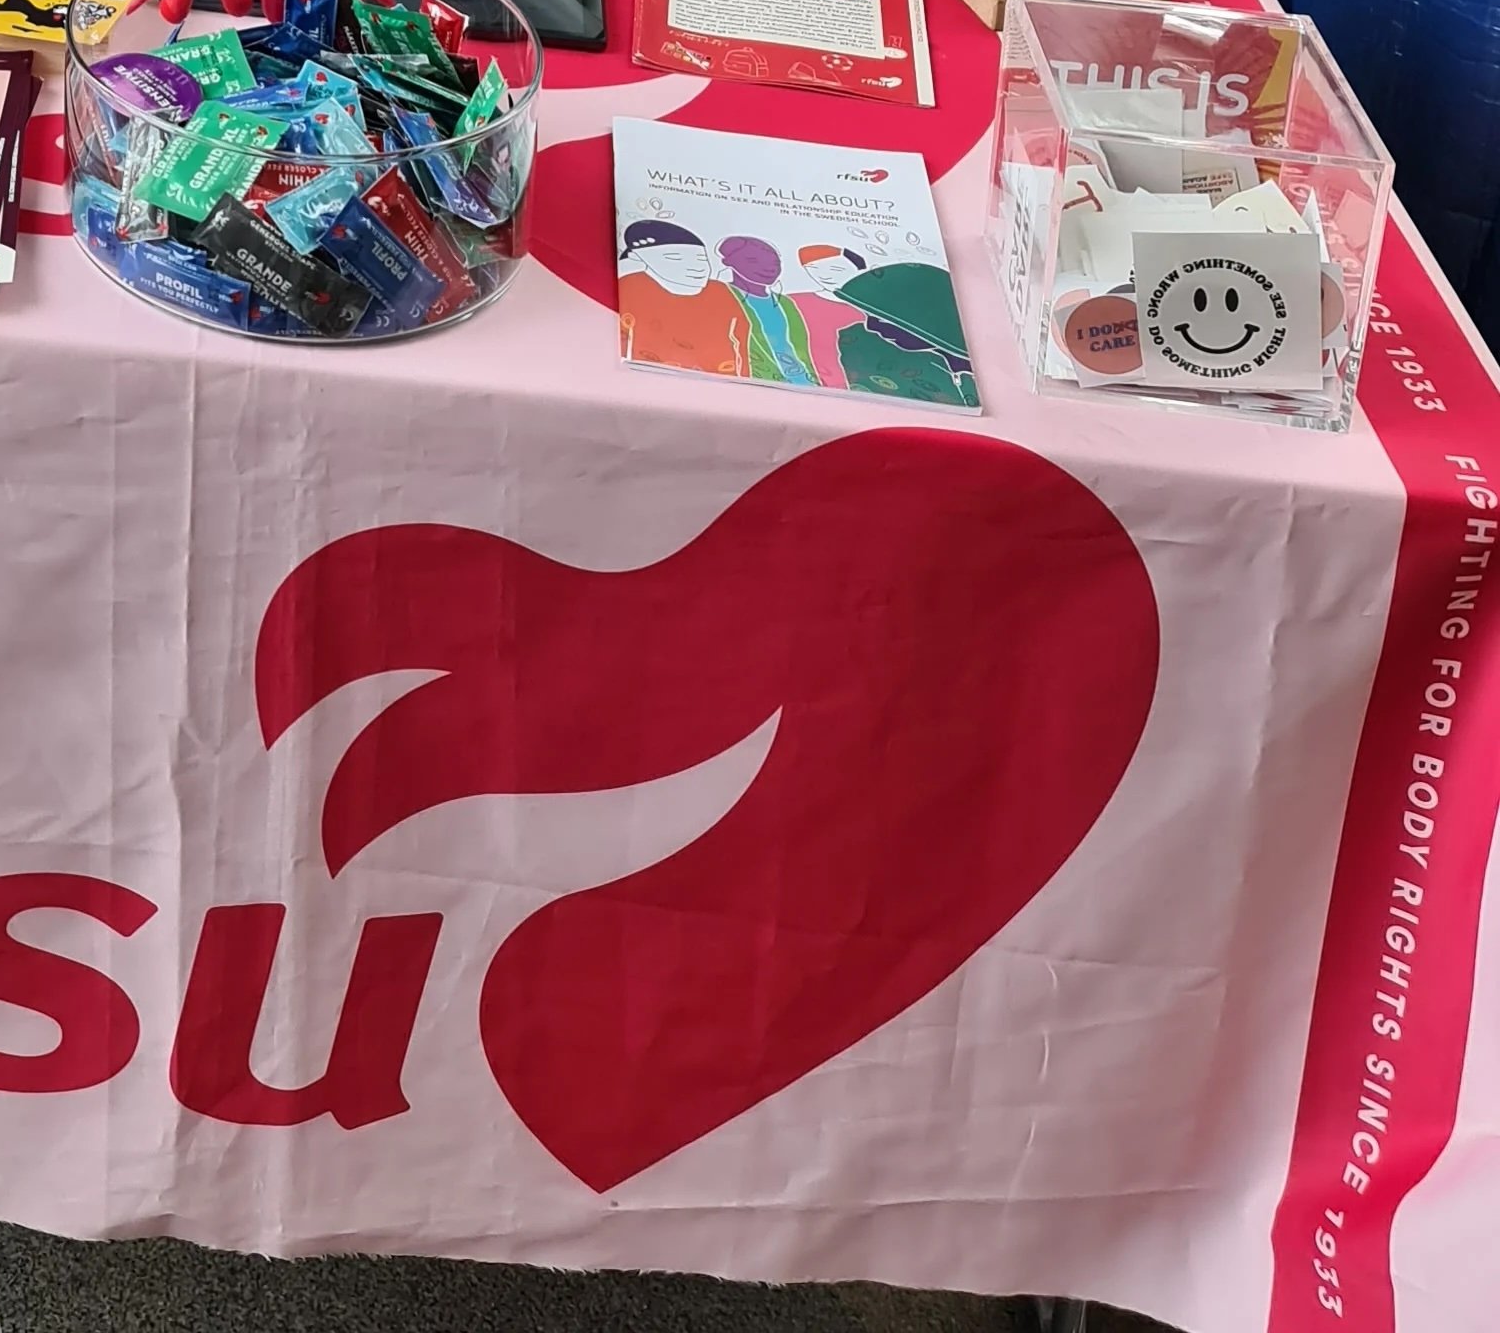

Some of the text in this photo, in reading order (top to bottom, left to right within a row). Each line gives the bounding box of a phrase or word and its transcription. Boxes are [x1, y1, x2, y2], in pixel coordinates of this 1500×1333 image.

[1199, 70, 1250, 118] IS
[222, 126, 239, 143] XL
[646, 168, 896, 212] WHAT'S IT ALL ABOUT?
[836, 173, 868, 182] rfsu
[648, 184, 712, 199] INFORMATION
[751, 199, 772, 207] AND
[773, 201, 842, 215] RELATIONSHIP
[844, 210, 899, 221] EDUCATION
[814, 213, 859, 223] SWEDISH
[861, 218, 900, 227] SCHOOL
[236, 247, 293, 294] GRANDE
[371, 240, 409, 281] PROFIL
[155, 272, 204, 299] PROFIL
[157, 283, 174, 295] YOU
[175, 288, 220, 314] PERFECTLY
[1076, 328, 1084, 341] I
[1090, 336, 1136, 352] CARE
[1385, 345, 1448, 413] 1933
[1311, 454, 1499, 1320] FIGHTING FOR BODY RIGHTS SINCE 1933
